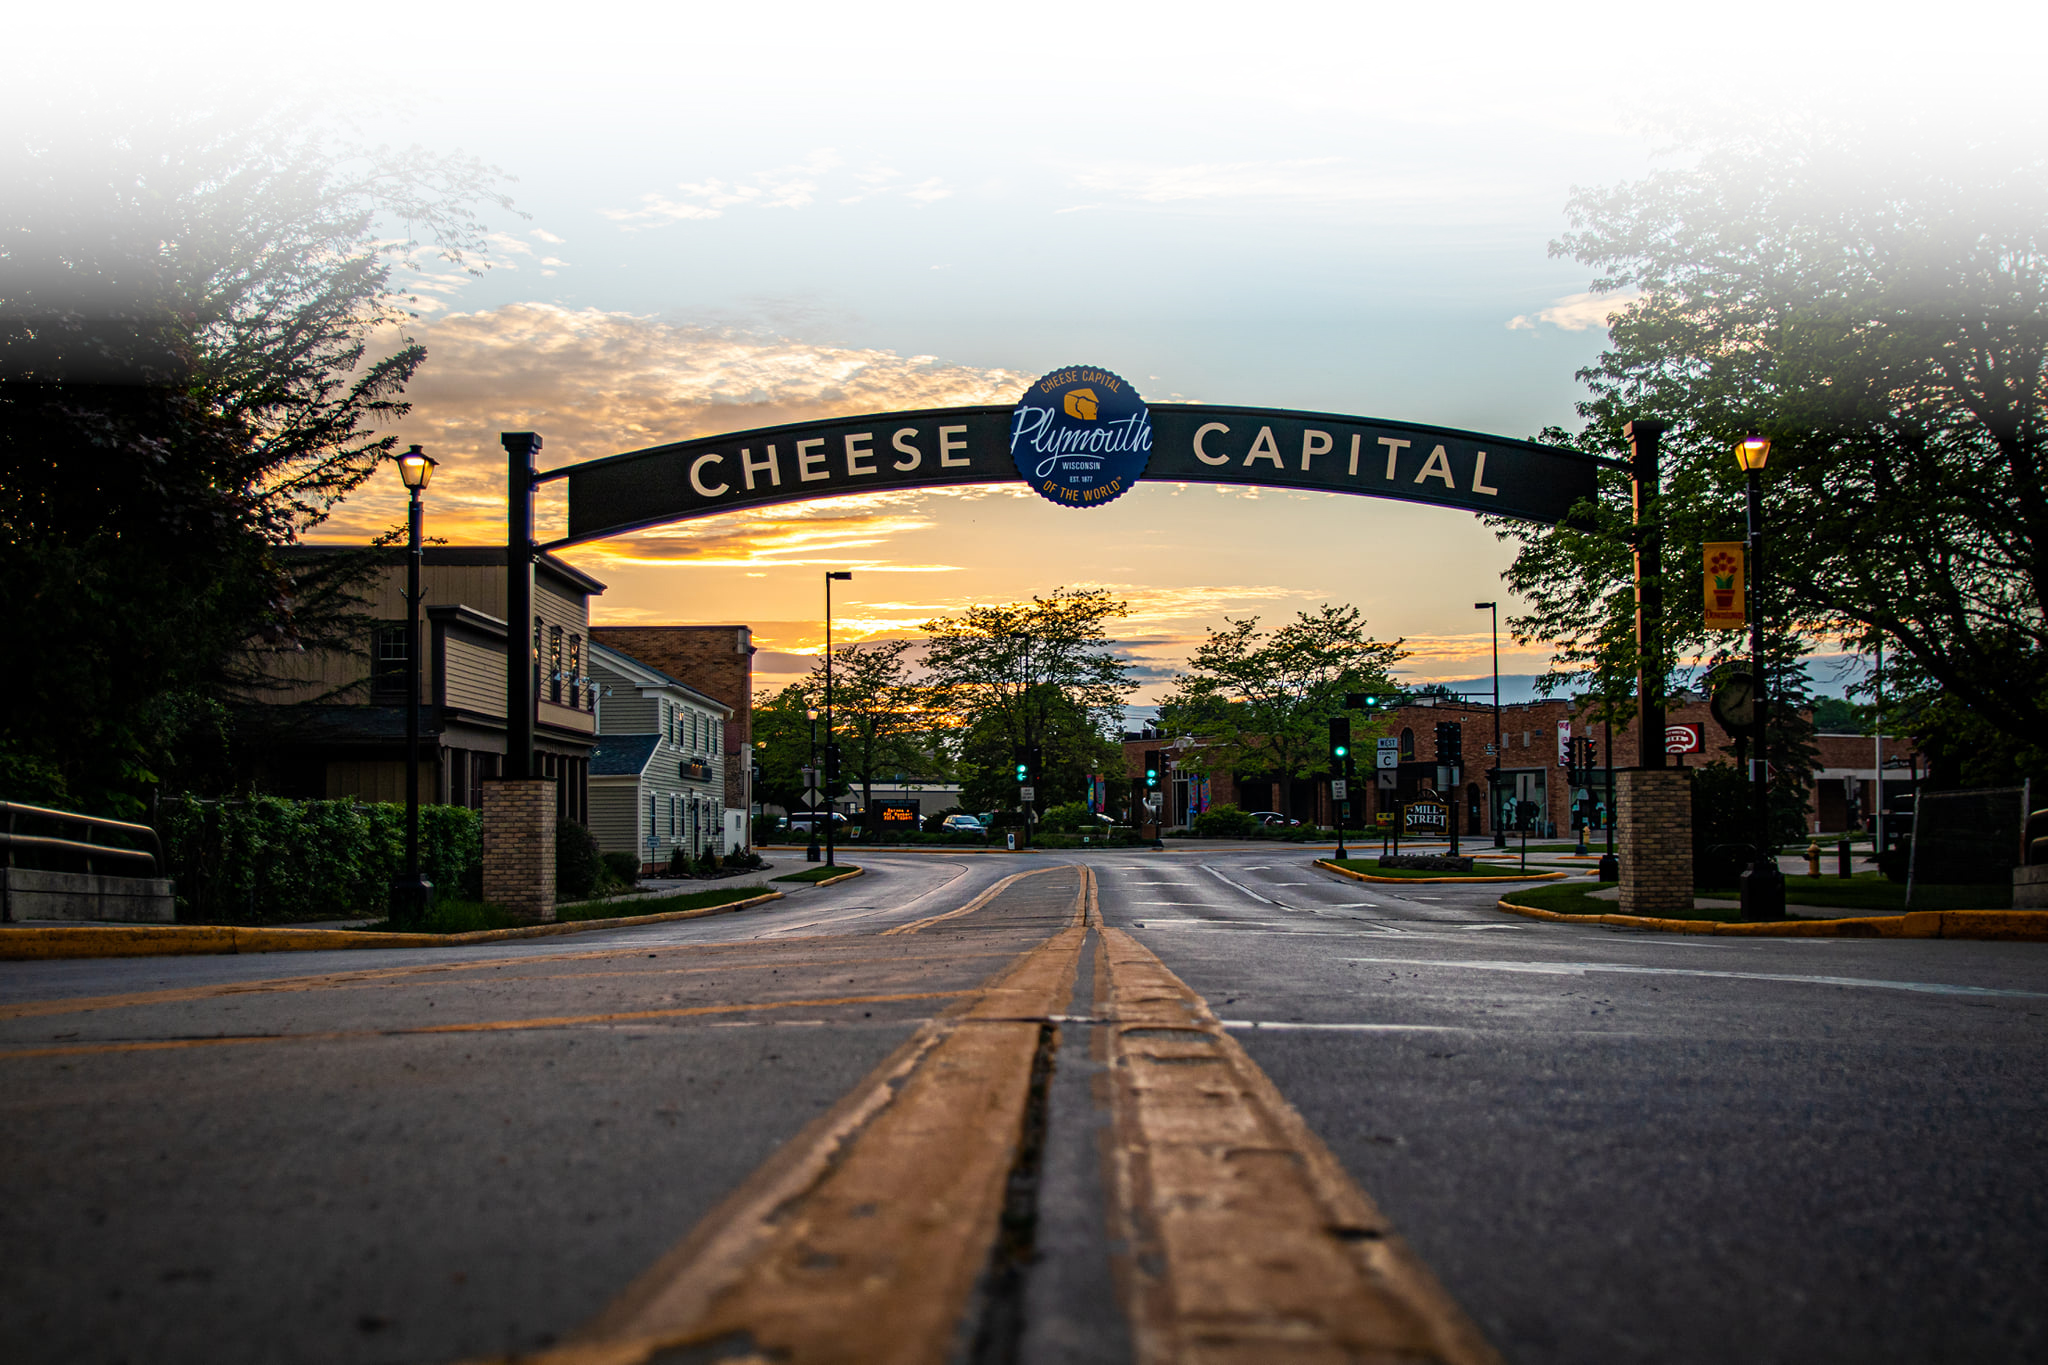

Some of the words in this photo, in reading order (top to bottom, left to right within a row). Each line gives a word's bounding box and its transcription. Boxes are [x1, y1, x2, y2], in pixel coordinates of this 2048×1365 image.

[1040, 370, 1077, 394] CHEESE
[1082, 370, 1122, 394] CAPITAL
[1010, 405, 1153, 478] Plymouth
[689, 425, 971, 497] CHEESE
[1193, 422, 1498, 496] CAPITAL
[1061, 461, 1101, 470] WISCONSIN
[1069, 475, 1081, 483] EST.
[1042, 479, 1058, 494] OF
[1060, 486, 1079, 501] THE
[1380, 739, 1395, 747] WEST
[1383, 755, 1392, 766] C
[1414, 805, 1439, 814] MILL
[1406, 814, 1447, 827] STREET
